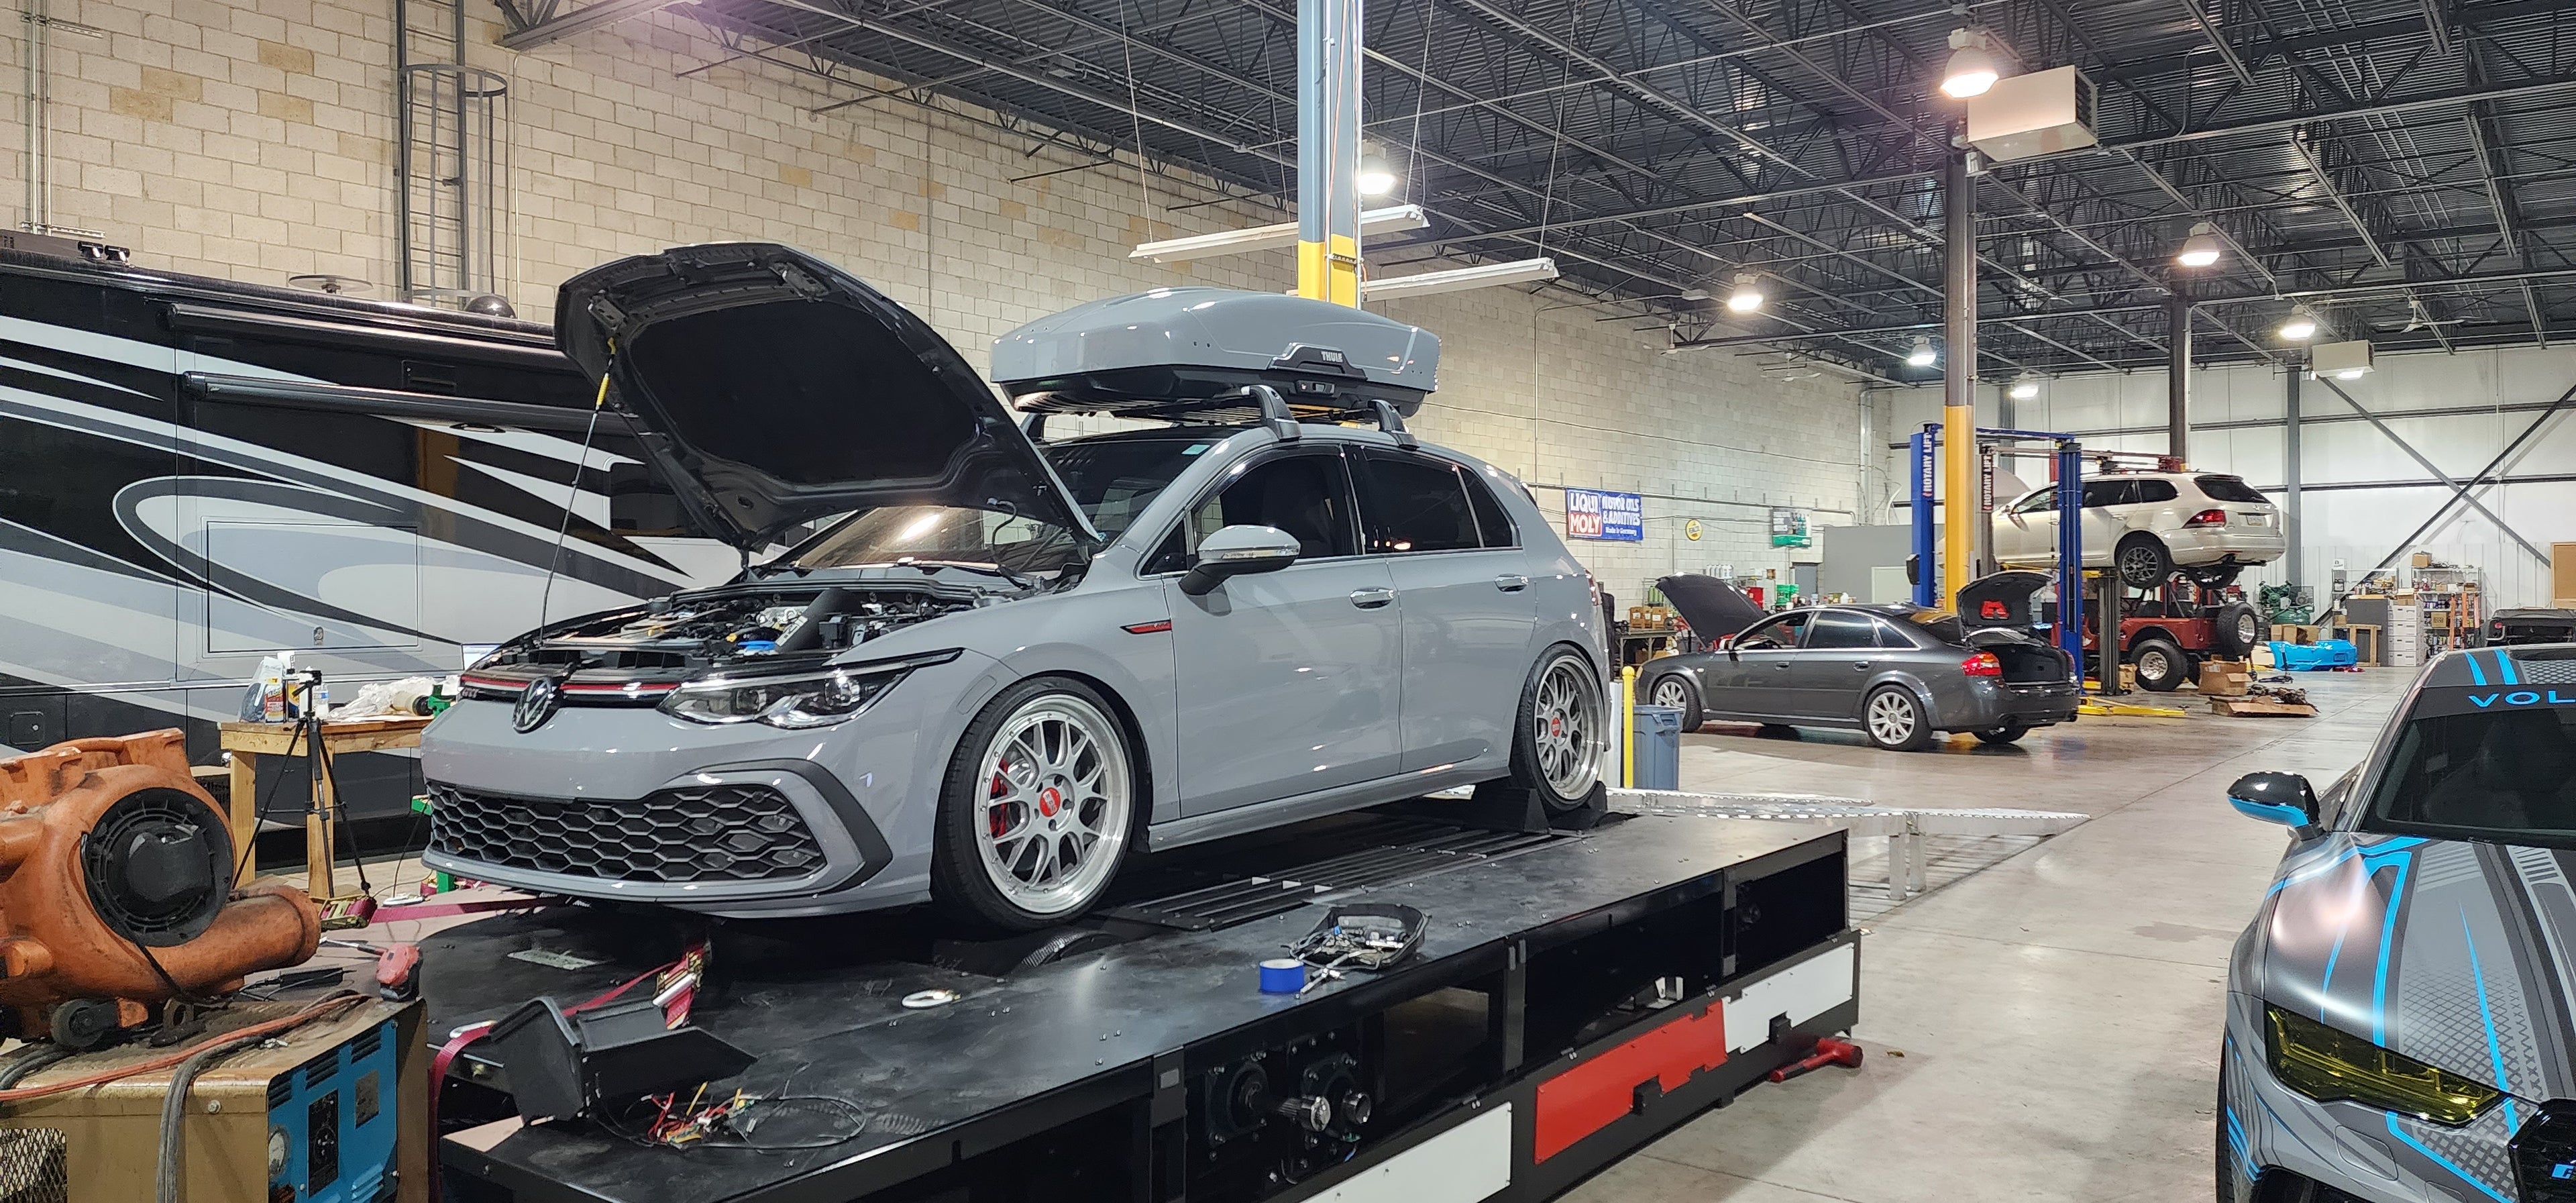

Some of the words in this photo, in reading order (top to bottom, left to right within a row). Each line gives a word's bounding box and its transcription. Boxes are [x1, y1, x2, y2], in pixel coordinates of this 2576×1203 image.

[1321, 351, 1343, 362] THULE
[1923, 433, 1932, 453] LIFT
[1923, 455, 1932, 492] ROTARY
[1984, 455, 1992, 472] LIFT
[1984, 474, 1992, 505] ROTARY
[1570, 492, 1599, 513] LIQUI
[1601, 494, 1625, 511] MOTOR
[1625, 497, 1640, 512] OILS
[1570, 513, 1601, 533] MOLY
[2468, 690, 2576, 707] VOL
